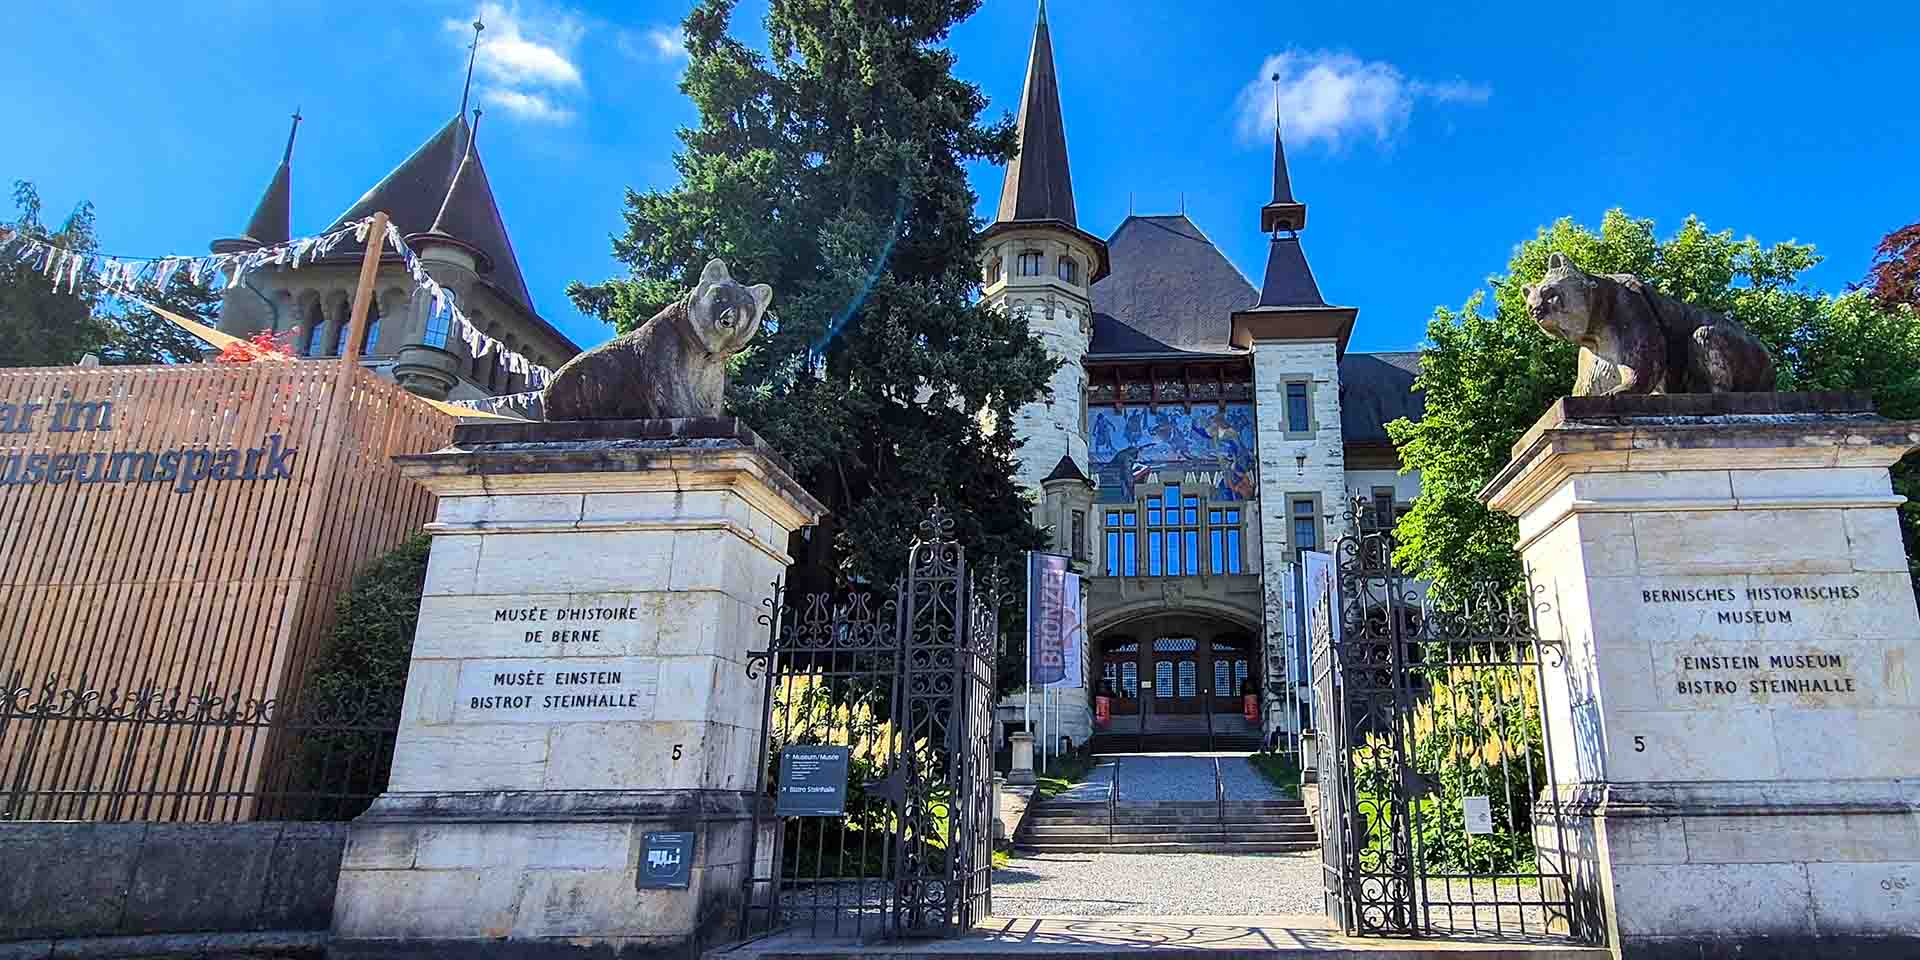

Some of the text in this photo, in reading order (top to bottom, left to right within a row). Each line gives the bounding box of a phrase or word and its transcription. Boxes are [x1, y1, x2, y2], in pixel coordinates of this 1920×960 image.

[48, 388, 113, 433] im
[1642, 586, 1861, 603] BERNISCHES HISTORISCHES
[494, 605, 638, 622] MUSÉE D'HISTOIRE
[1717, 610, 1793, 624] MUSEUM
[524, 630, 601, 643] DE BERNE
[1683, 655, 1842, 670] EINSTEIN MUSEUM
[493, 669, 622, 686] MUSÉE EINSTEIN
[1677, 679, 1856, 695] BISTRO STEINHALLE
[470, 694, 639, 710] BISTROT STEINHALLE
[671, 743, 684, 761] 5
[1634, 736, 1646, 752] 5
